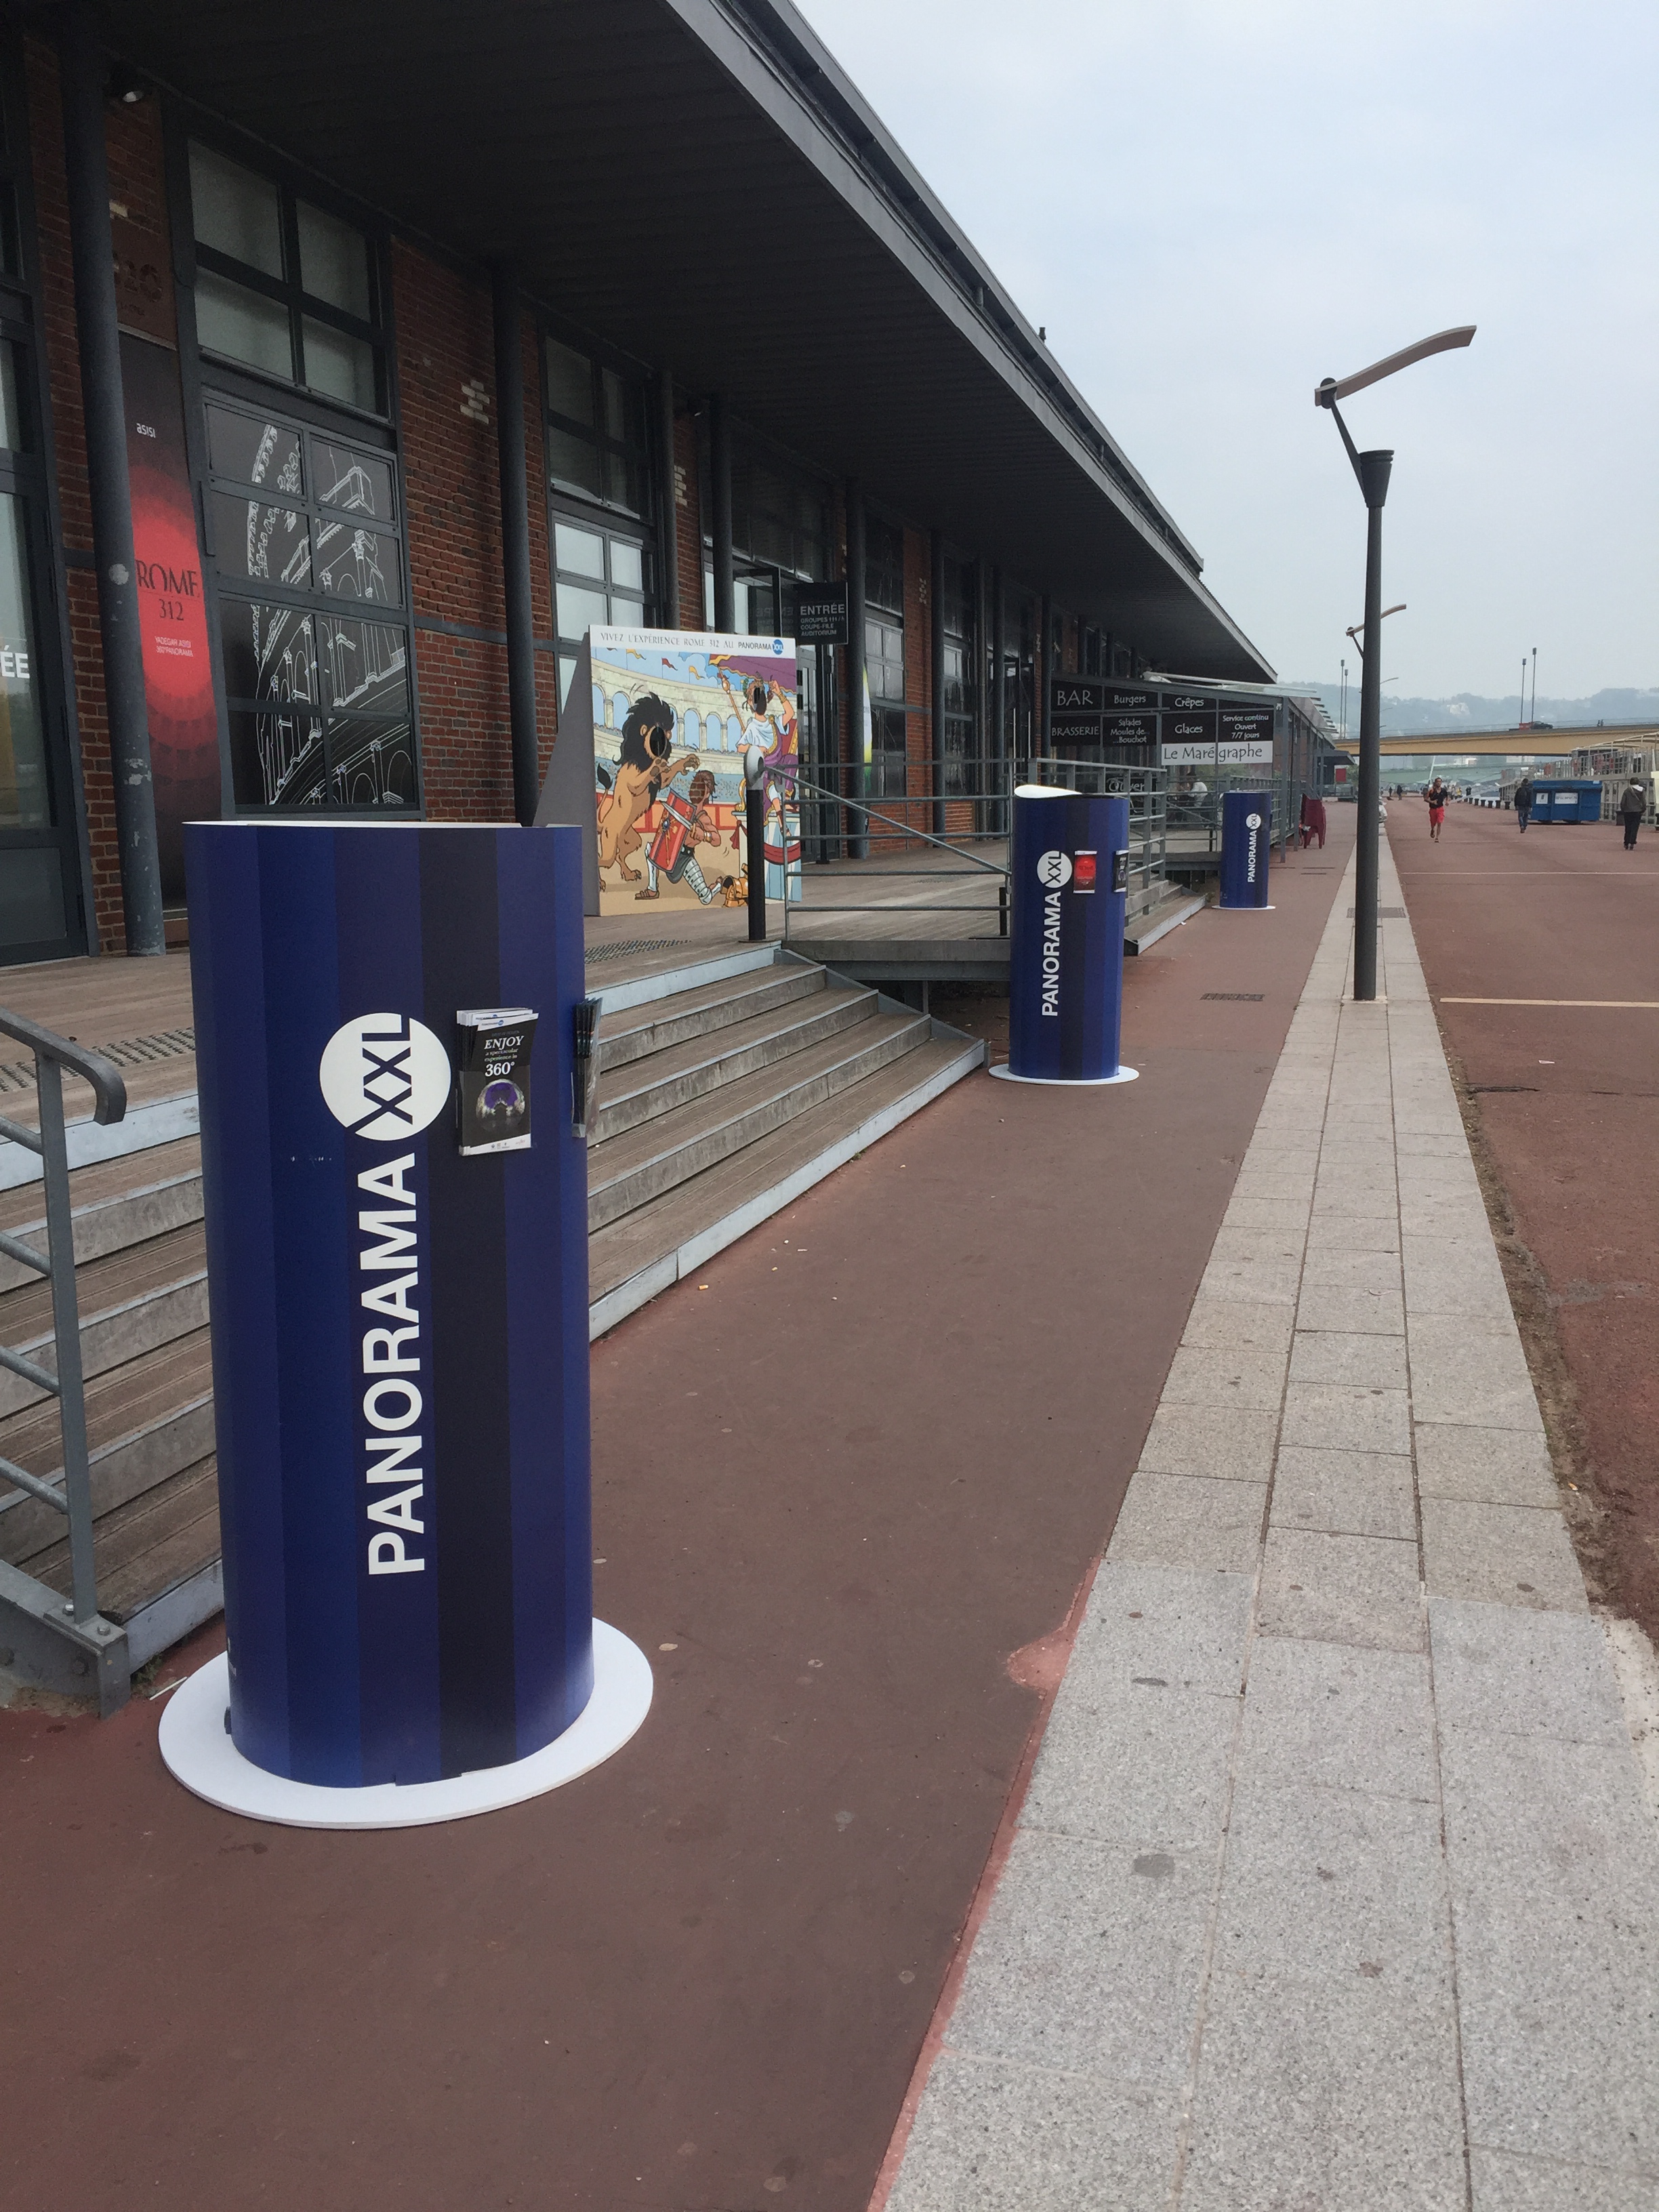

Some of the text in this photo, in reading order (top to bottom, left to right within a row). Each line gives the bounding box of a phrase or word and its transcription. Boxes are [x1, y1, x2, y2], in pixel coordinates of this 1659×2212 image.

[136, 423, 156, 438] asisi
[159, 598, 184, 621] 312
[800, 602, 845, 616] ENTRÉE
[600, 632, 623, 642] VIVEZ
[628, 634, 680, 646] L'EXPÉRIENCE
[684, 638, 705, 647] ROME
[710, 639, 719, 648] 312
[723, 640, 734, 649] AU
[738, 641, 772, 651] PANORAMA
[1057, 690, 1093, 706] BAR
[1113, 695, 1146, 706] Burgers
[1174, 697, 1204, 710] Crêpes
[1118, 718, 1142, 726] Salades
[1174, 723, 1203, 734] Glaces
[1051, 726, 1099, 736] BRASSERIE
[1244, 732, 1260, 740] jours
[1164, 747, 1178, 760] Le
[1248, 830, 1257, 882] PANORAMA
[1042, 891, 1061, 1016] PANORAMA
[484, 1036, 525, 1050] ENJOY
[490, 1048, 519, 1057] spectacular
[485, 1061, 515, 1077] 360°
[358, 1153, 425, 1574] PANORAMA
